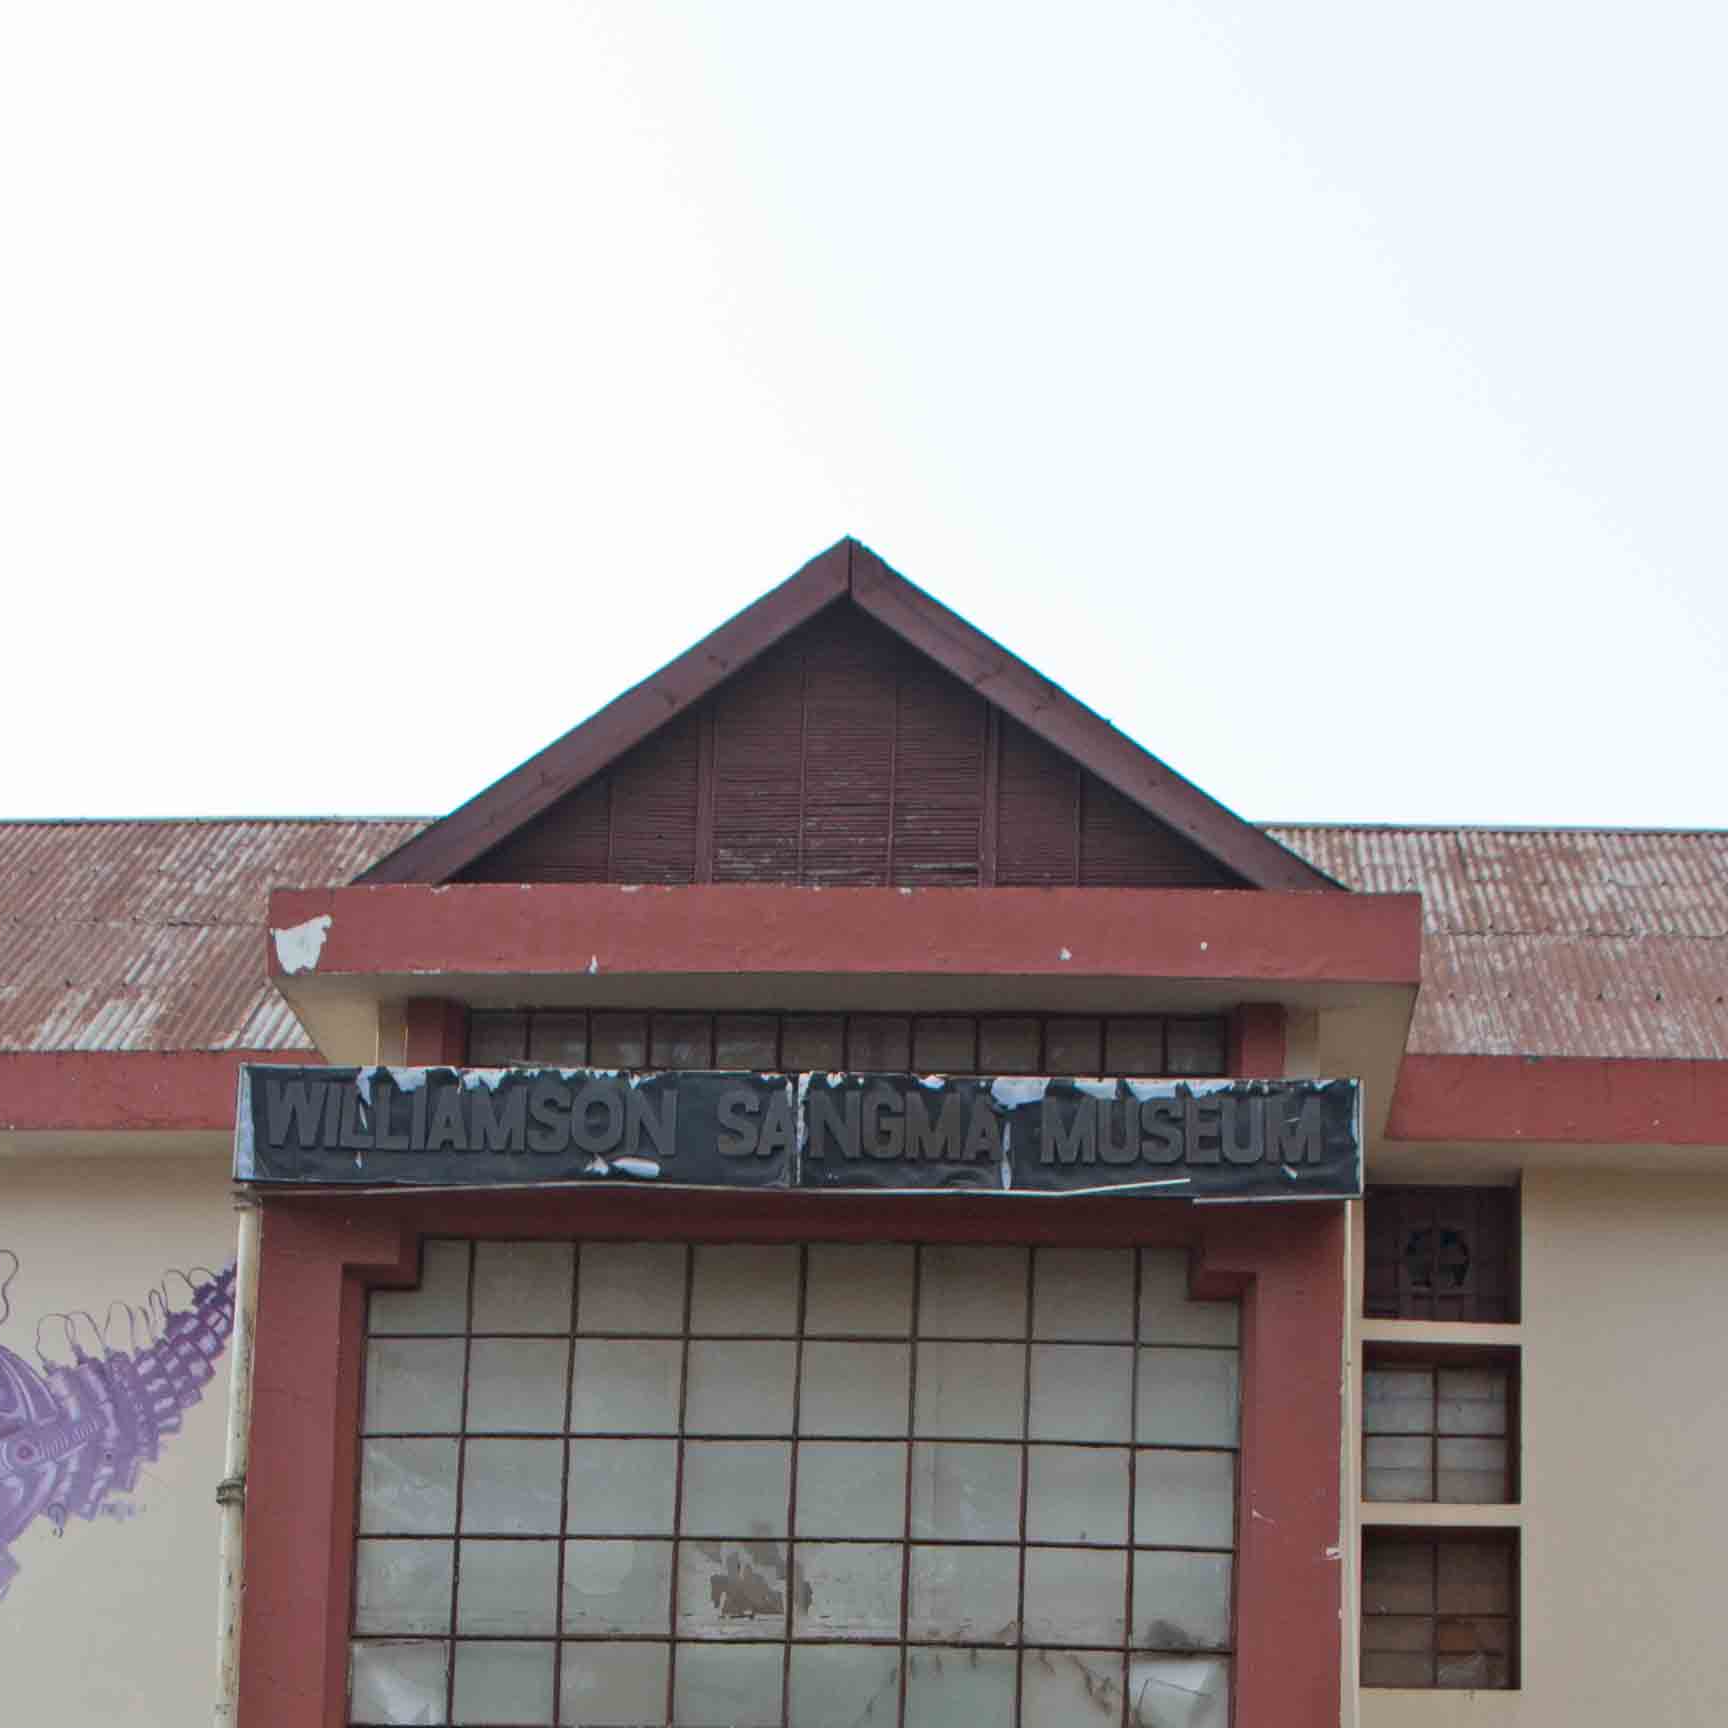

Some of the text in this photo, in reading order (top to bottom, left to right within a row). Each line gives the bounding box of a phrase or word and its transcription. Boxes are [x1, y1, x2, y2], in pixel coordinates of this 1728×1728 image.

[267, 1079, 1323, 1167] WILLIAMSON SANGMA MUSEUM
